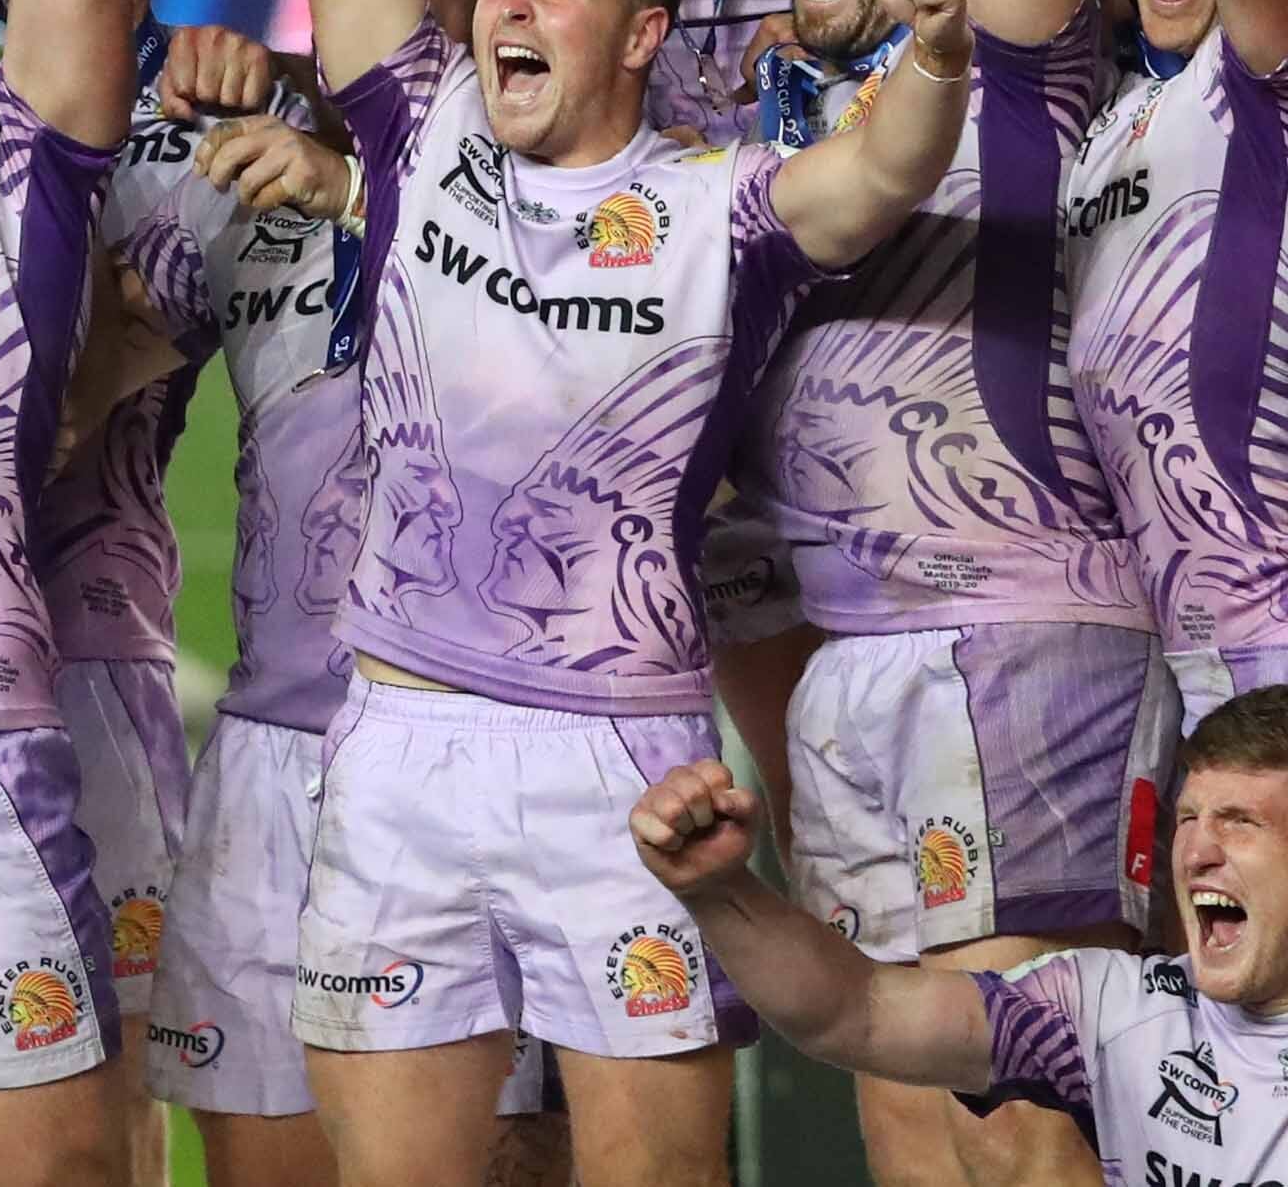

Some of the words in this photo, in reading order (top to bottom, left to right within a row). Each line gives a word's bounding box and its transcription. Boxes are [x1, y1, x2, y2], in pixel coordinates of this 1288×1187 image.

[629, 182, 671, 245] RUGBY
[485, 267, 665, 336] comms
[918, 561, 953, 571] Exeter
[956, 564, 993, 574] Chiefs
[934, 553, 974, 563] Official
[923, 571, 958, 580] Match
[934, 580, 978, 589] 2019-20
[941, 816, 978, 878] RUGBY
[605, 924, 647, 1001] EXETER
[656, 922, 700, 990] RUGBY
[40, 957, 86, 1014] RUGBY
[321, 969, 406, 995] comms
[148, 1024, 210, 1054] omms
[1159, 1113, 1180, 1131] THE
[1164, 1106, 1214, 1135] SUPPORTING
